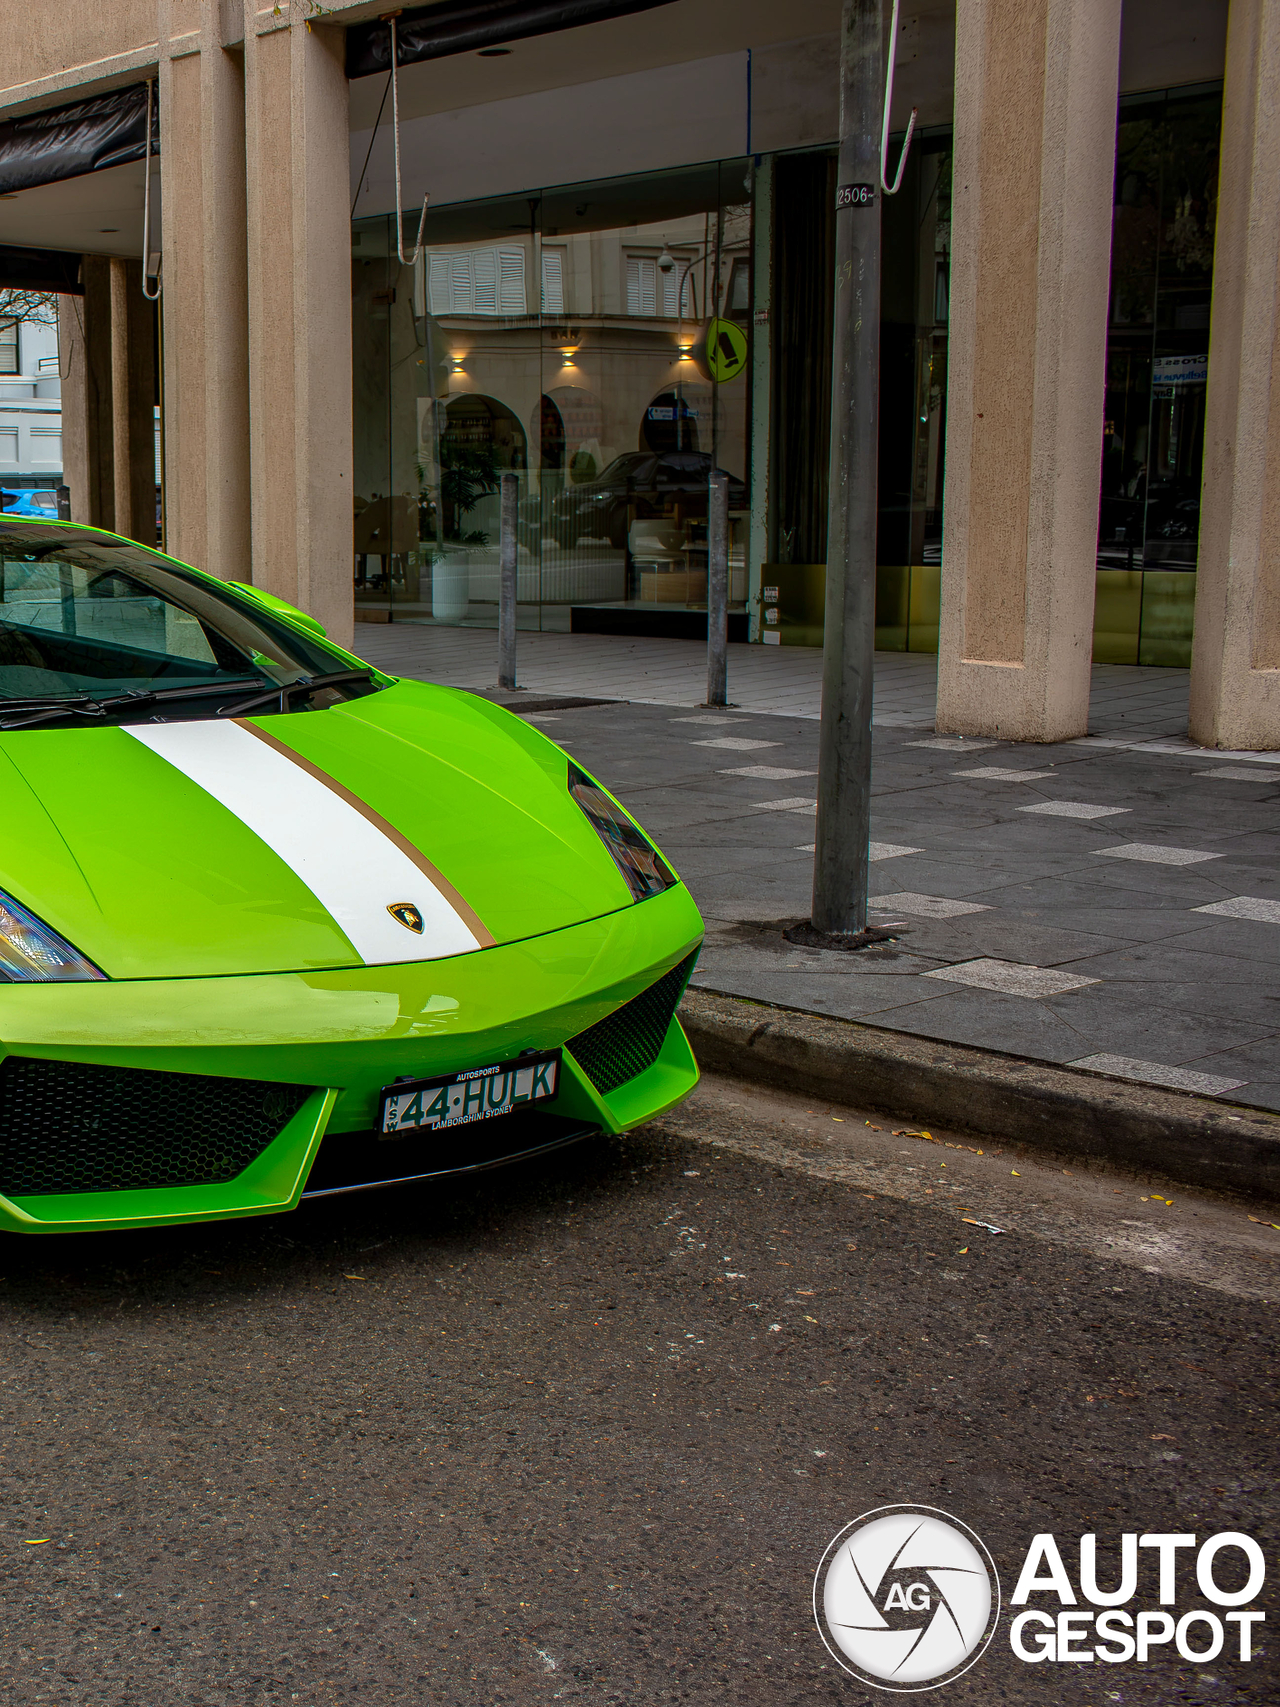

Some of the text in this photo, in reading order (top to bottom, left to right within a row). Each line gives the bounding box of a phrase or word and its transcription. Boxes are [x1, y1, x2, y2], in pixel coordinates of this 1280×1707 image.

[456, 1065, 500, 1082] AUTOSPORTS
[431, 1103, 514, 1130] LAMBORGHINI SYDNEY
